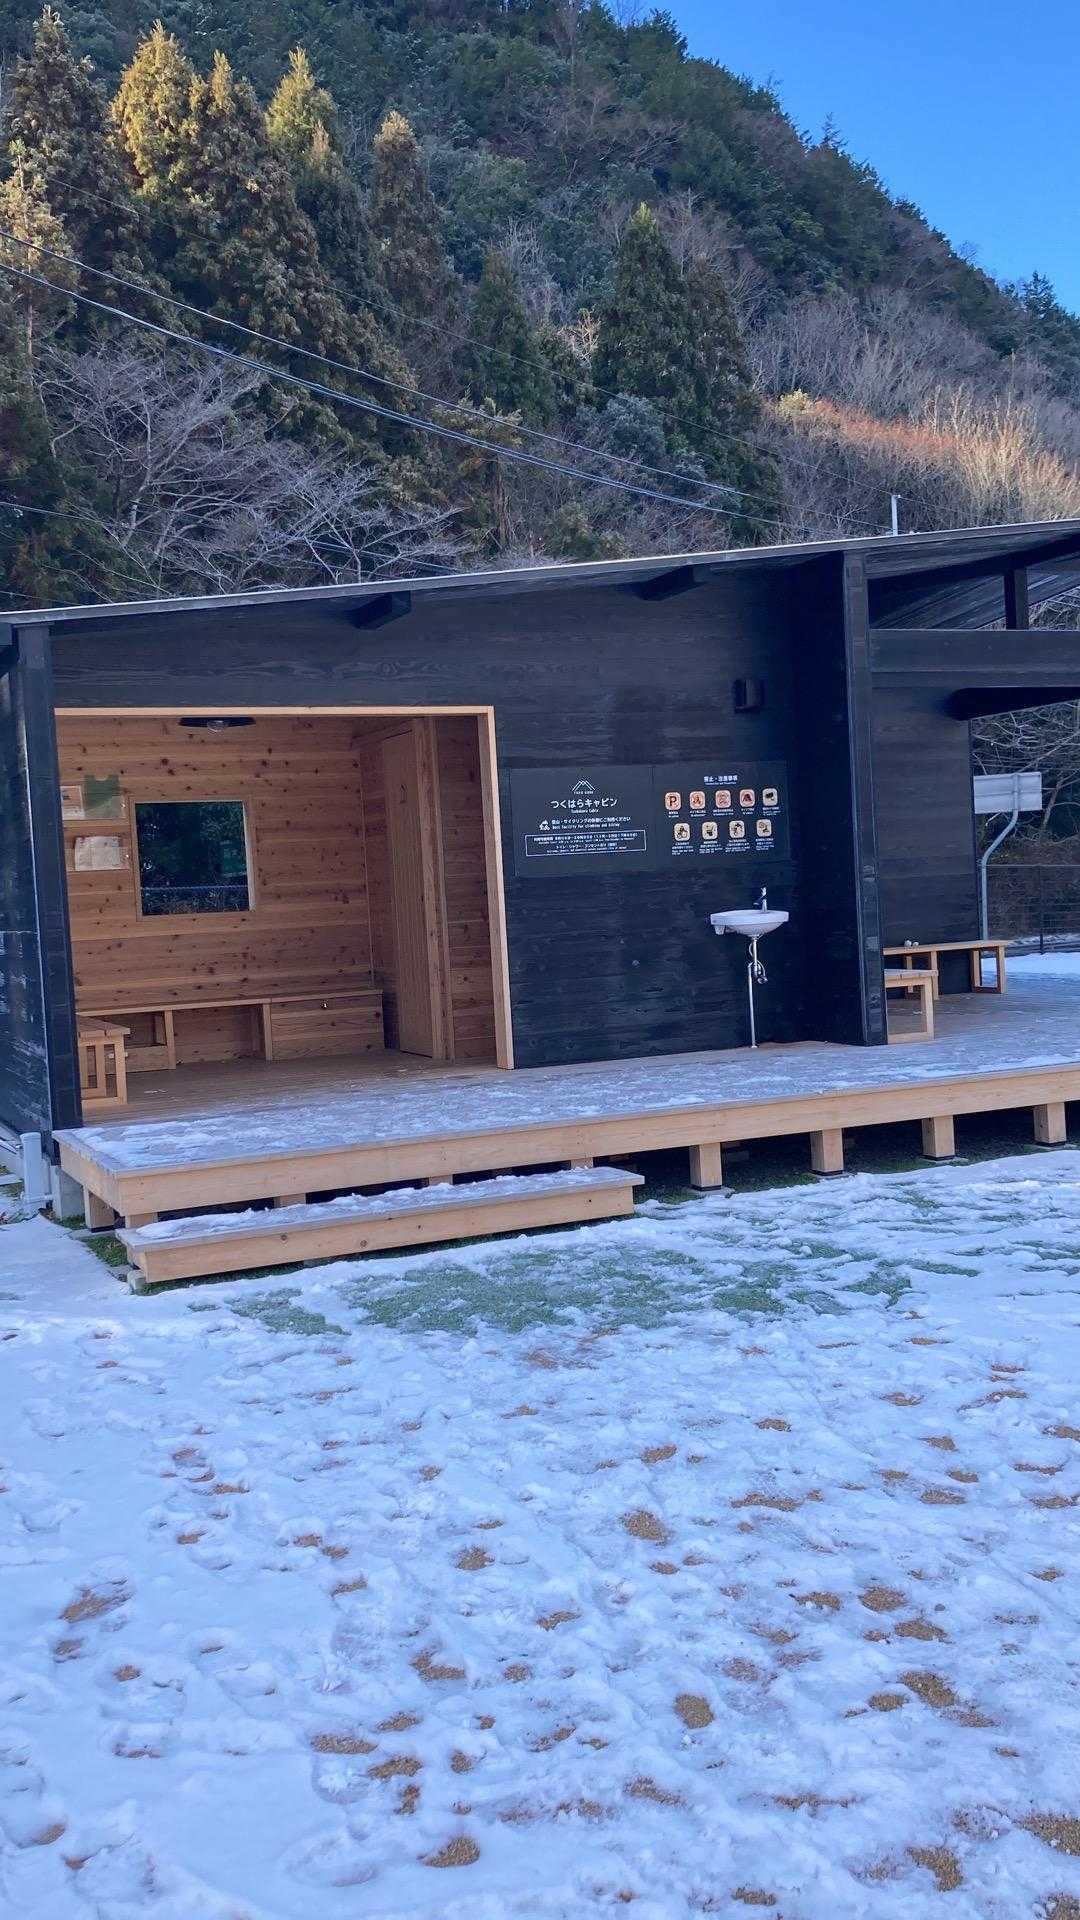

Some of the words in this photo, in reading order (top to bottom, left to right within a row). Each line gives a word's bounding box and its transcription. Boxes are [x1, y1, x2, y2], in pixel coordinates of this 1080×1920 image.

[550, 798, 618, 809] つくはらキャビン
